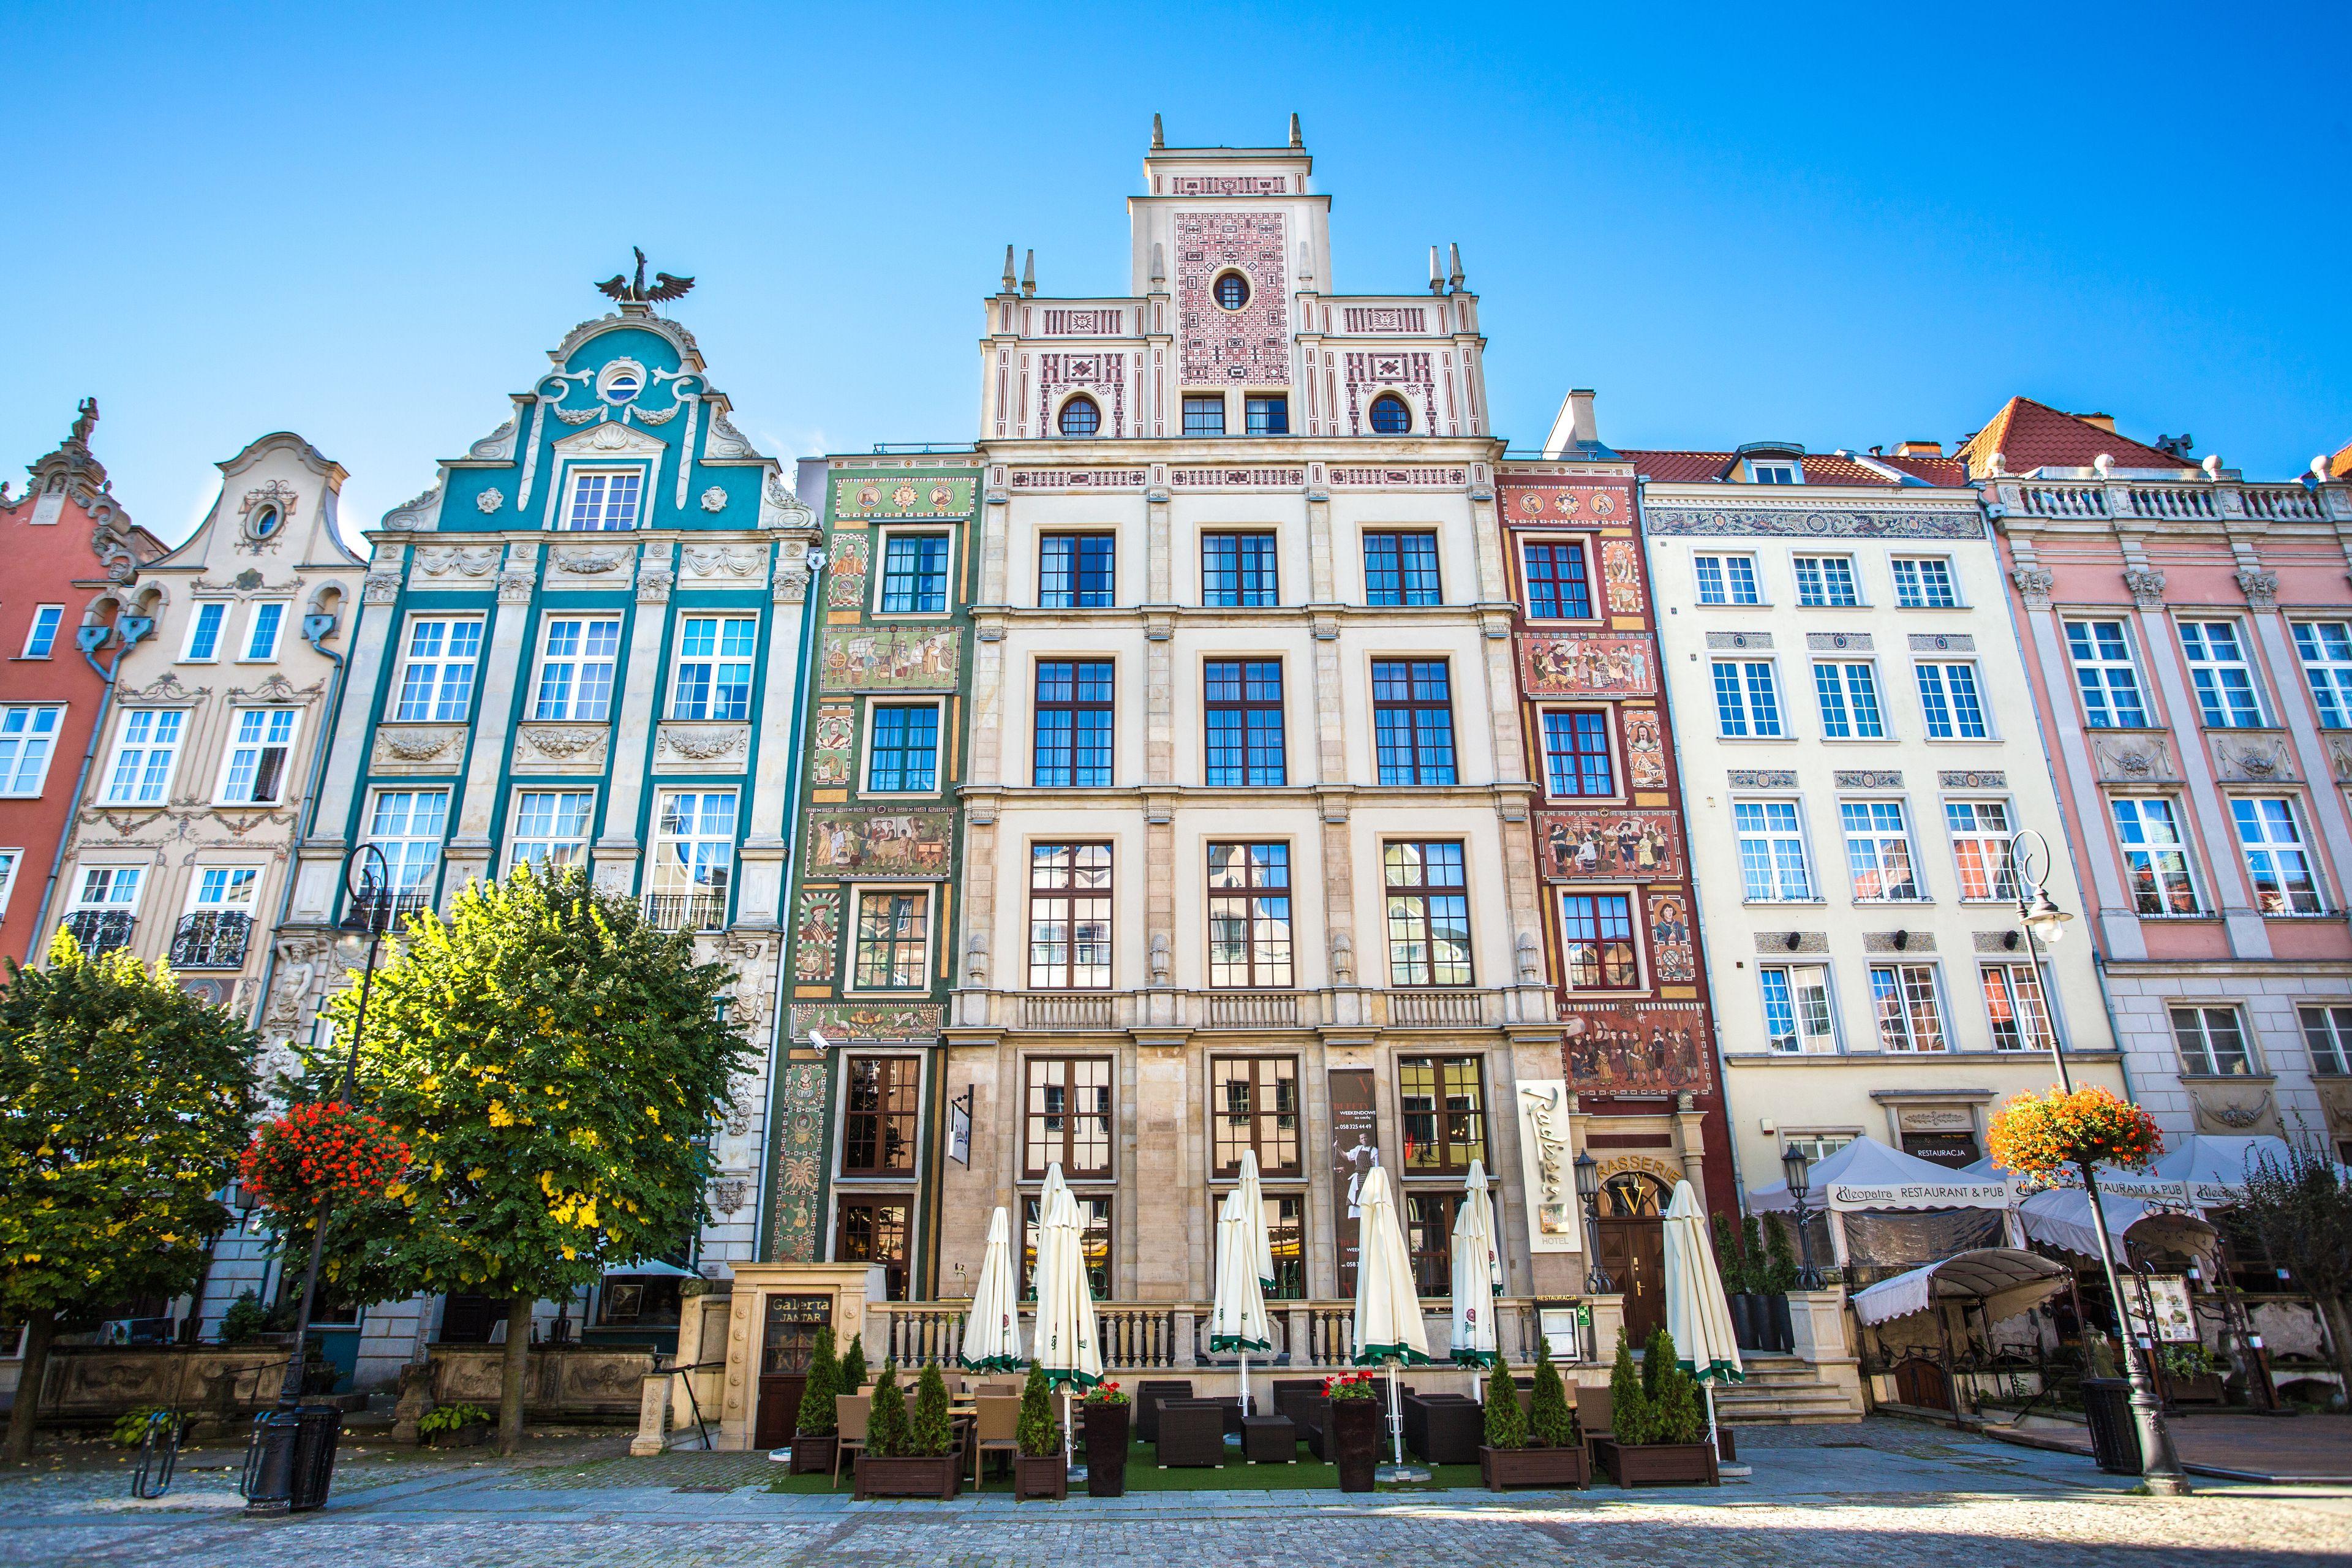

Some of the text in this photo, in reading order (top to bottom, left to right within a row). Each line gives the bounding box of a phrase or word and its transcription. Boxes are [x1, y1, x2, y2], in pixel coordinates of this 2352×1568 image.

[1521, 1087, 1567, 1202] Radisson
[1596, 1155, 1682, 1186] RASSERIE
[1836, 1186, 2004, 1202] Kleopatra RESTAURANT & PUB
[2151, 1184, 2160, 1194] &
[2162, 1185, 2182, 1195] PUB
